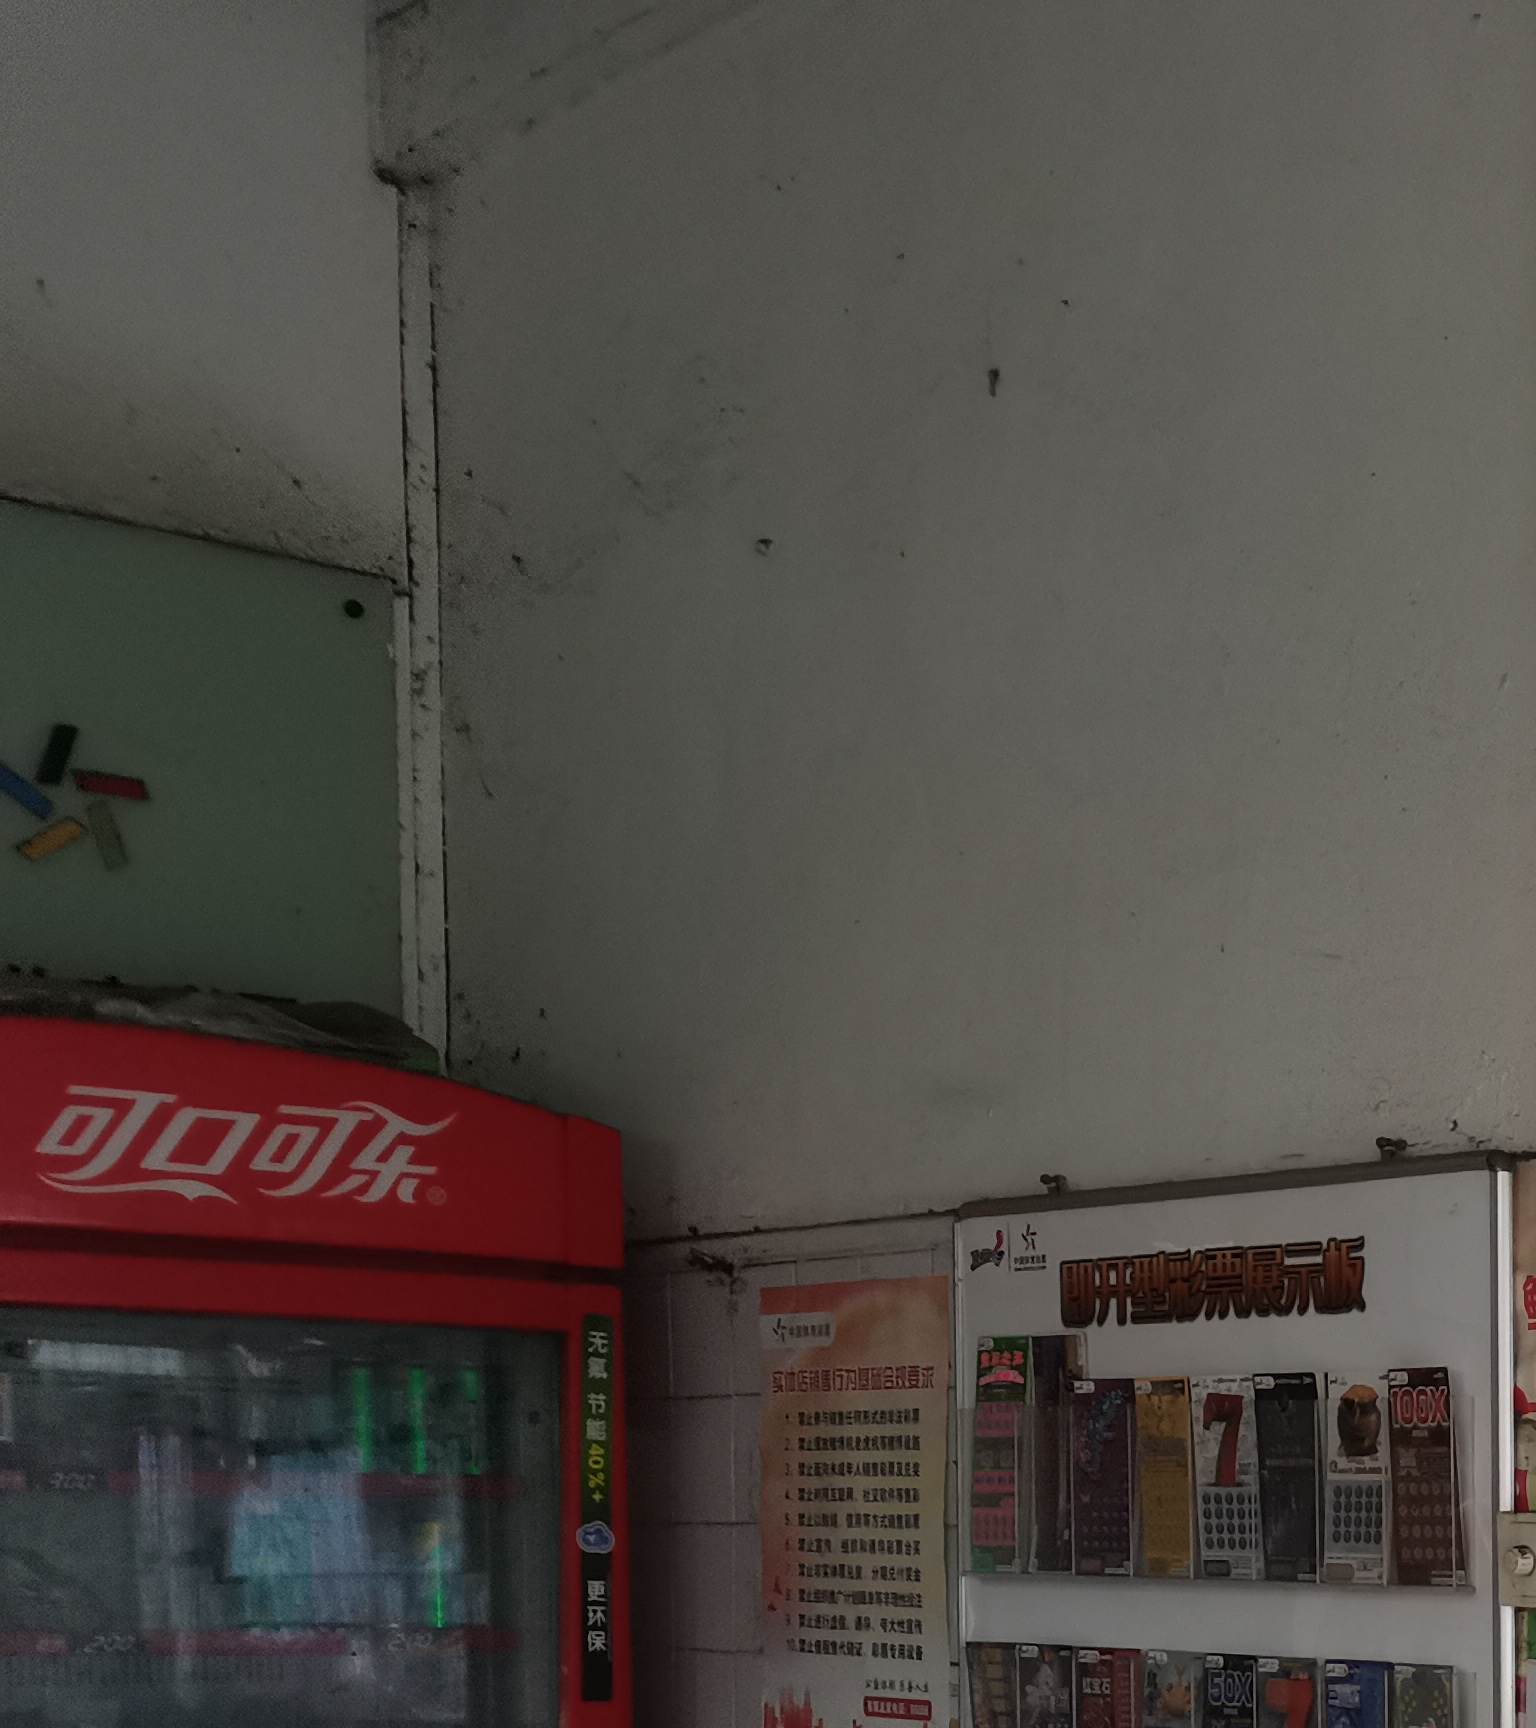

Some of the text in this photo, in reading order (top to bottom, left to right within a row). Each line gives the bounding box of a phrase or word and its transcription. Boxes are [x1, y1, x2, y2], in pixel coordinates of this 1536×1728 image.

[35, 1084, 457, 1204] 可口可乐
[1060, 1236, 1366, 1328] 即开型彩票展示板
[1390, 1386, 1448, 1427] 100X
[585, 1579, 609, 1653] 更环保
[1207, 1670, 1254, 1707] 50X
